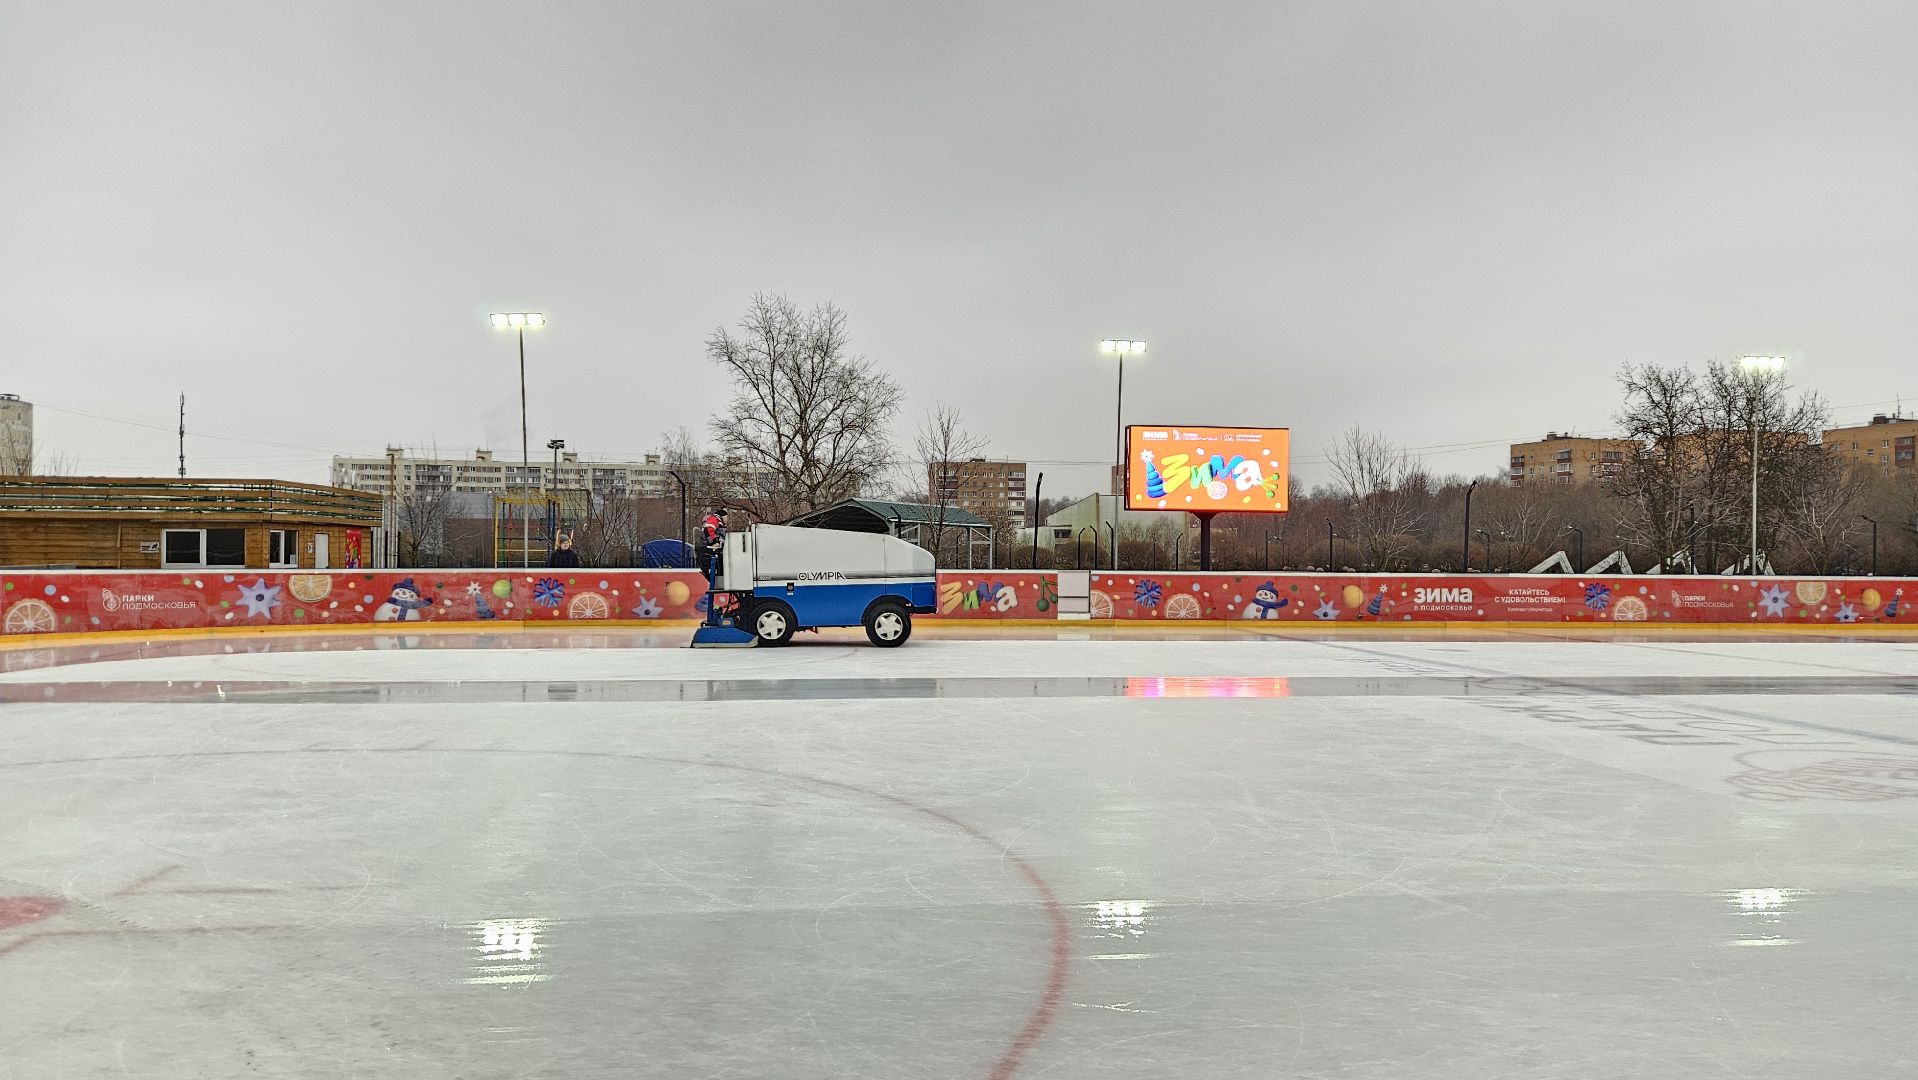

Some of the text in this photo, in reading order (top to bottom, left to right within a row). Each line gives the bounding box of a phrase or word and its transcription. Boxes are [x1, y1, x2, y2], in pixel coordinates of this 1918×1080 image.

[798, 571, 846, 581] OLYMPIA
[1509, 587, 1550, 596] КАТАЙТЕСЬ
[122, 594, 155, 602] ПАРКИ
[1501, 596, 1566, 604] УДОВОЛЬСТВИЕМ!
[122, 601, 196, 610] ПОДМОСКОВЬЯ
